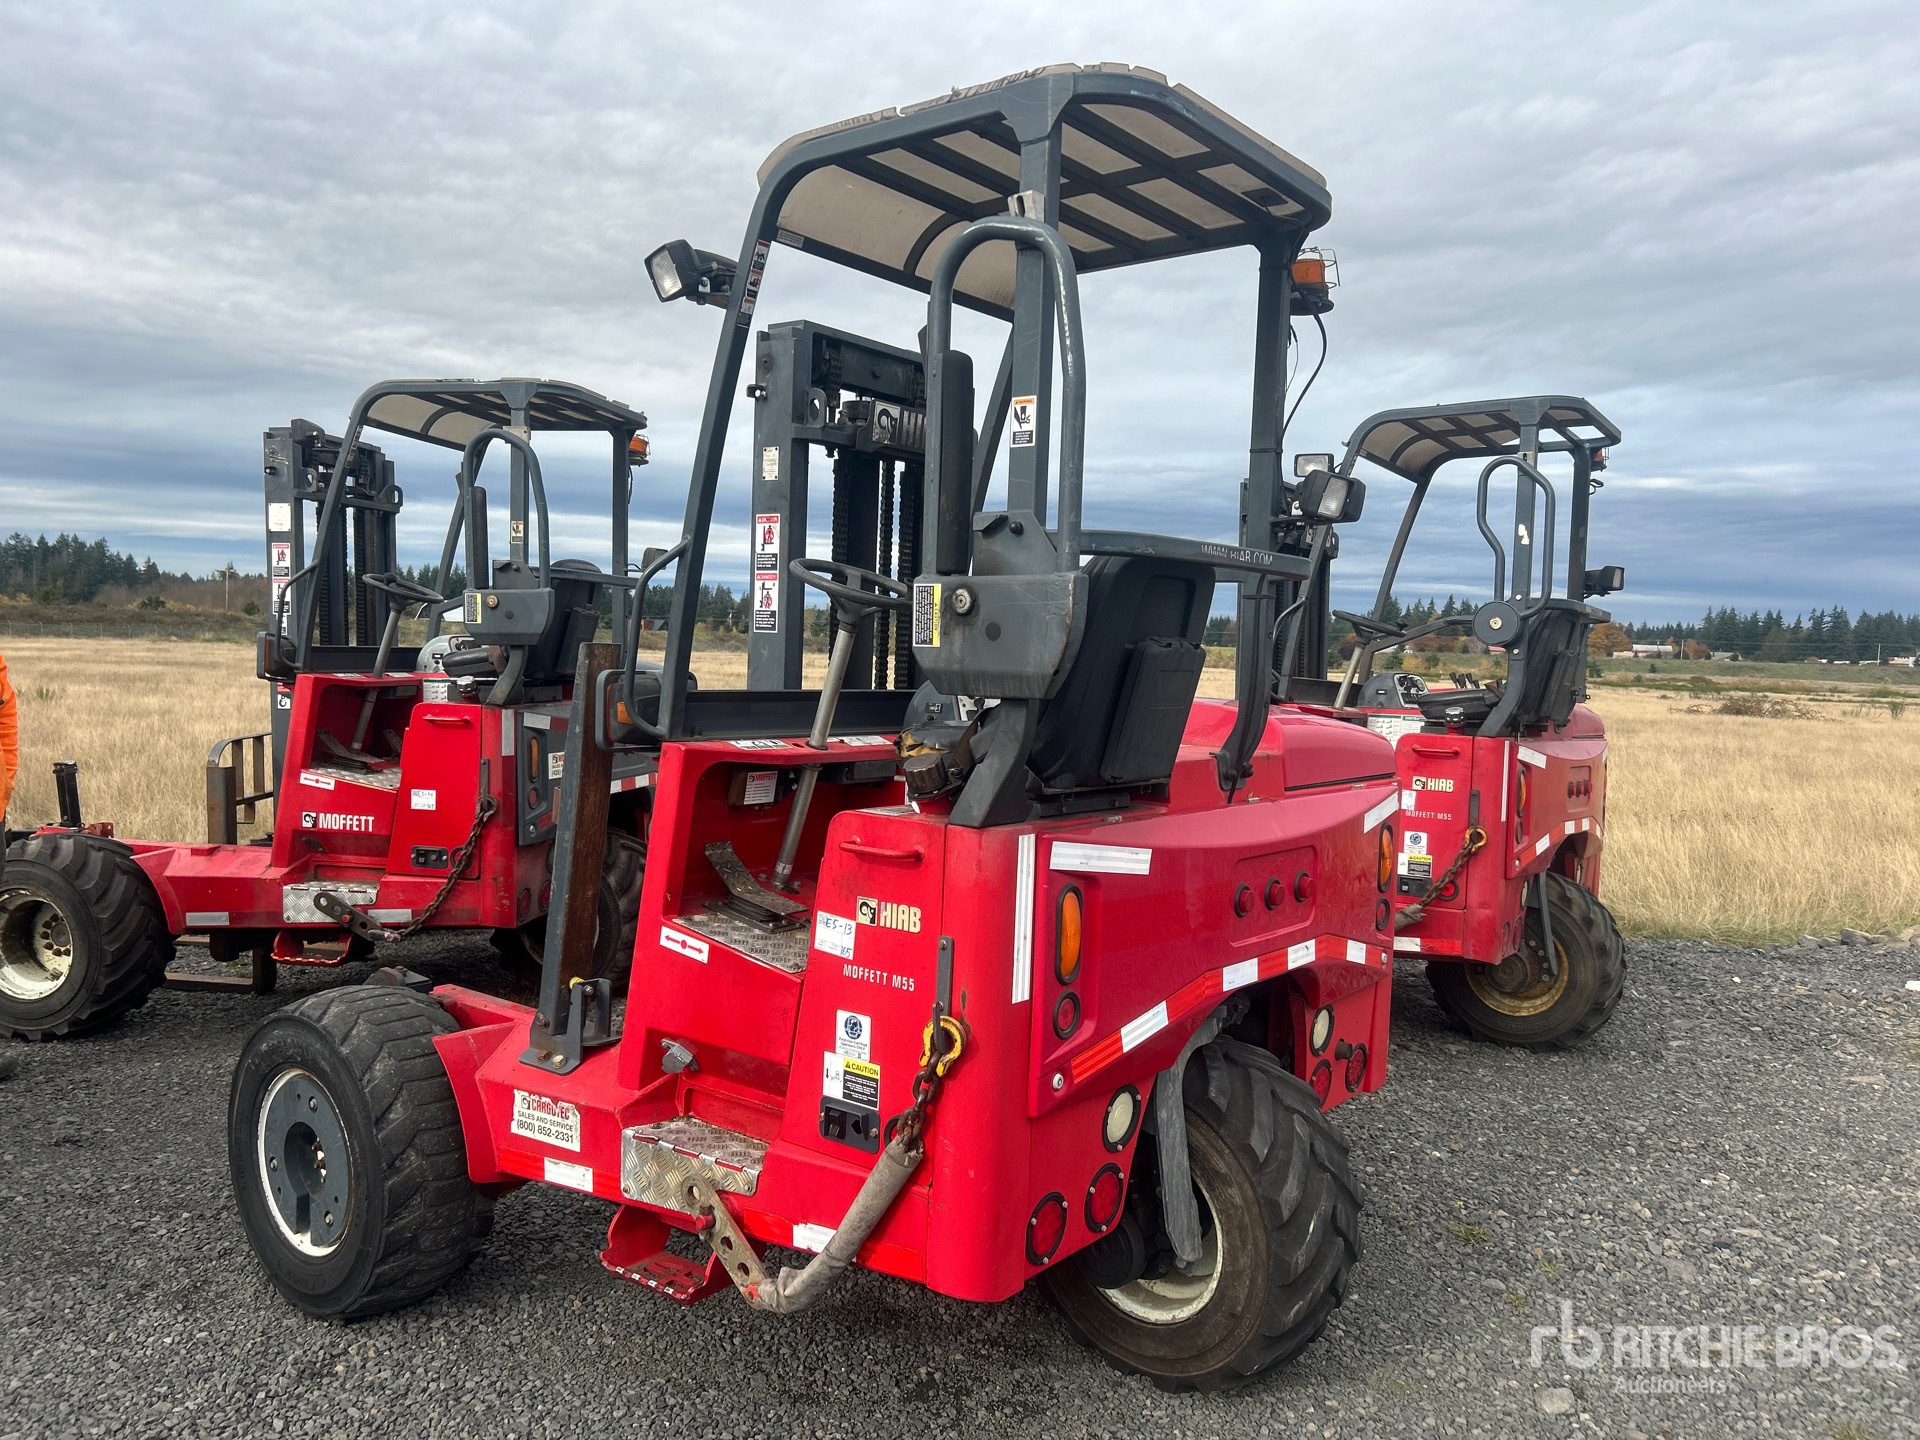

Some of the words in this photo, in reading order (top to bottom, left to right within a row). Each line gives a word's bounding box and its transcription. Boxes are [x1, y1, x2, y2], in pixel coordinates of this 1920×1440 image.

[1427, 778, 1454, 792] HIAB
[318, 812, 375, 832] MOFFETT
[1405, 810, 1434, 819] MOFFETT
[879, 901, 922, 933] HIAB
[843, 963, 888, 986] MOFFETT
[892, 974, 915, 992] M55
[851, 1062, 879, 1077] CAUTION
[517, 1119, 535, 1134] (800)
[537, 1124, 574, 1144] 852-2331
[518, 1110, 536, 1121] SALES
[536, 1115, 548, 1125] AND
[549, 1118, 574, 1132] SERVICE
